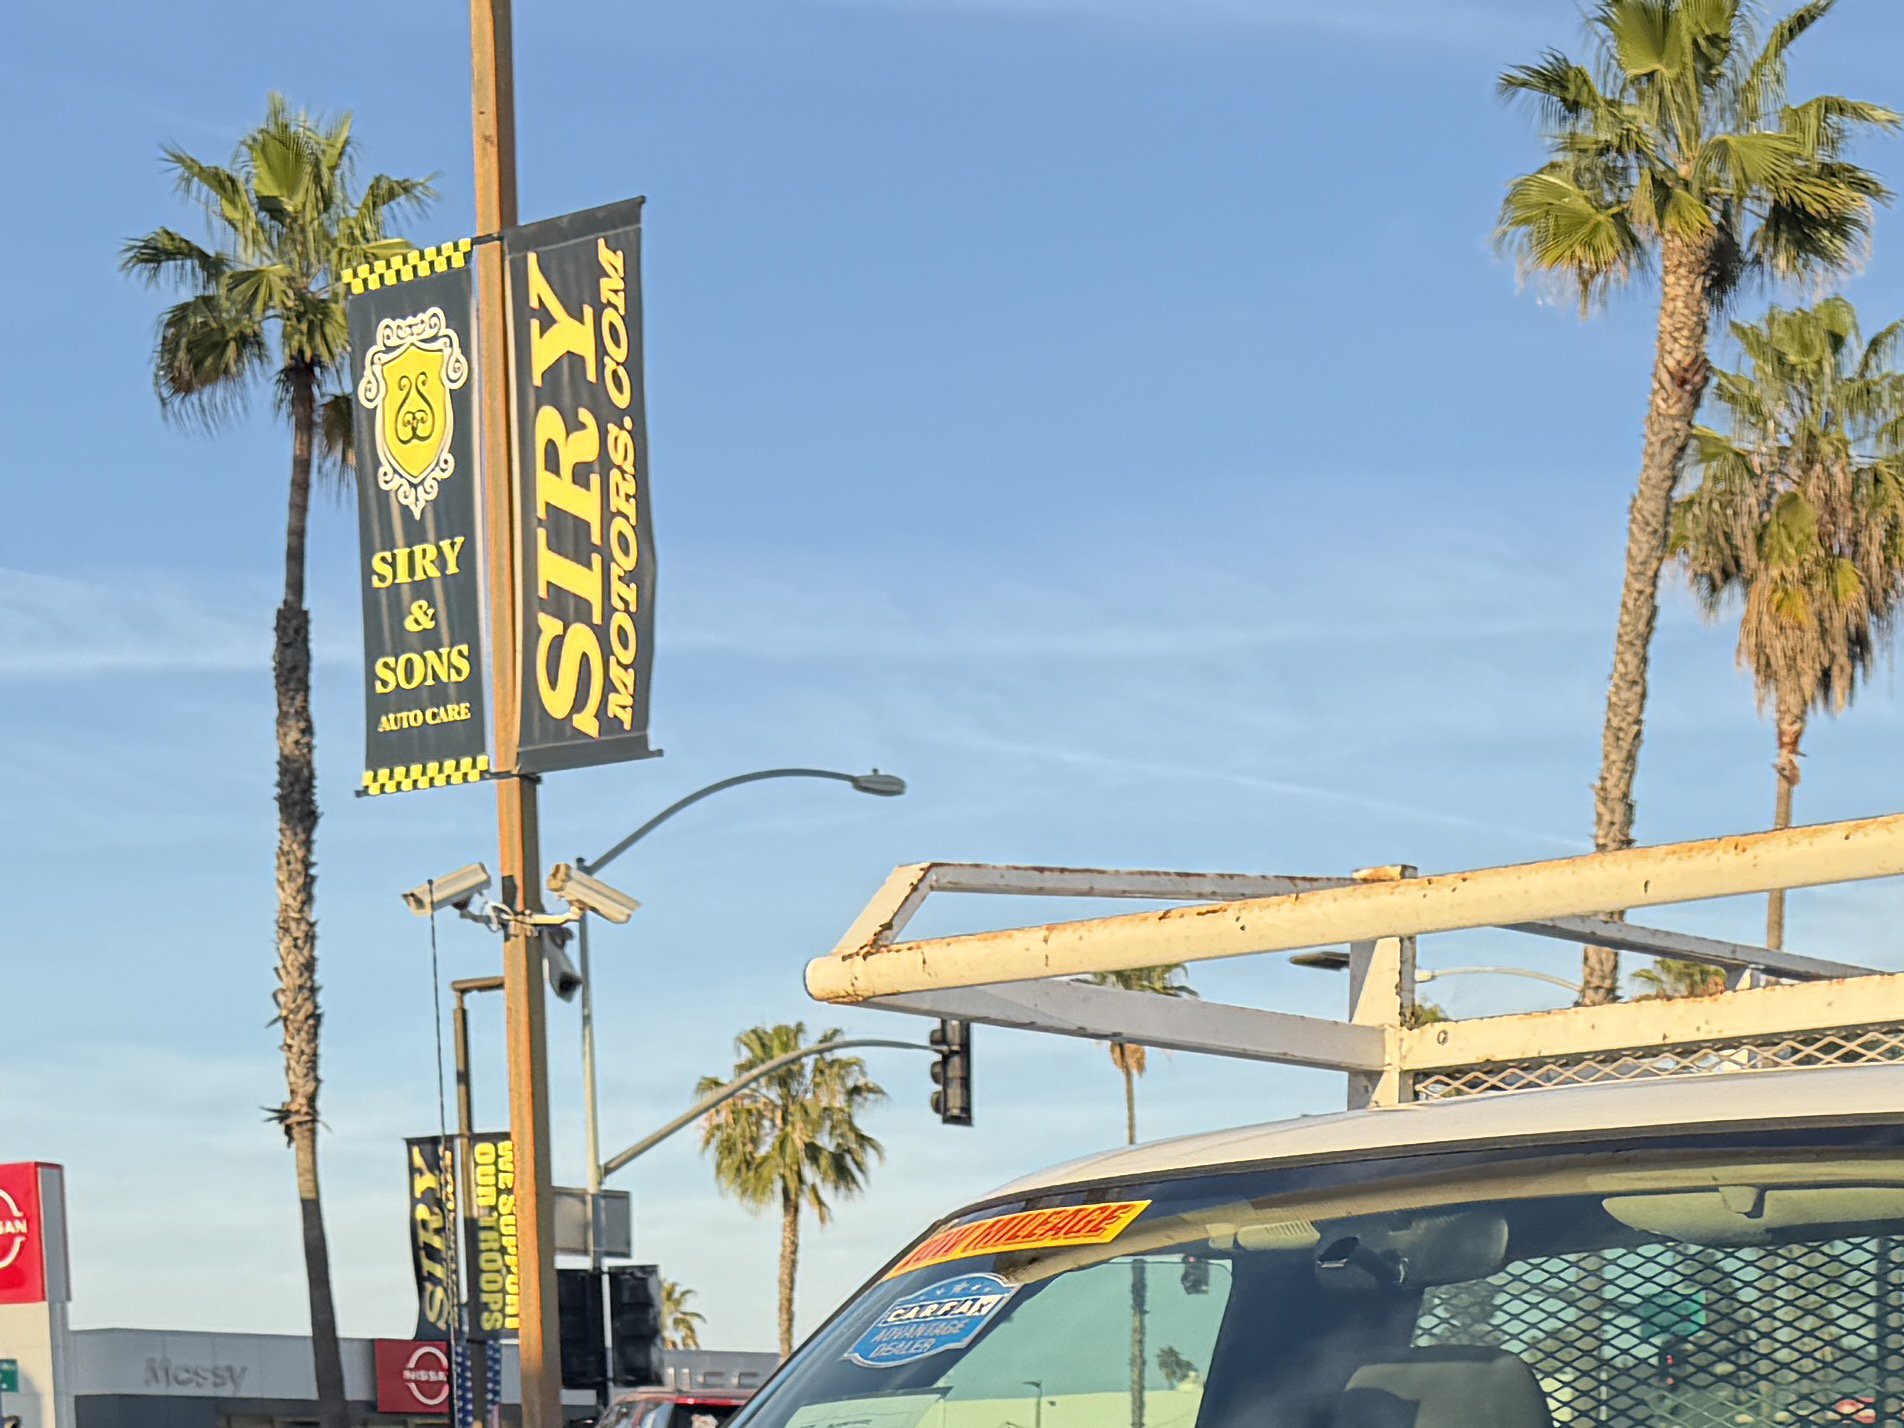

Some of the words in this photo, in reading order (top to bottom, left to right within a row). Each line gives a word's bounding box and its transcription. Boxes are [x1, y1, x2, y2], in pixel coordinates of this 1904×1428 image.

[527, 250, 604, 740] SIRY
[597, 238, 641, 732] MOTORS.COM
[370, 536, 466, 590] SIRY
[403, 599, 437, 633] &
[373, 644, 472, 694] SONS
[376, 707, 422, 733] AUTO
[425, 702, 472, 727] CARE
[474, 1142, 497, 1207] OUR
[869, 1338, 938, 1359] DEALER
[872, 1319, 970, 1343] ADVANTAGE
